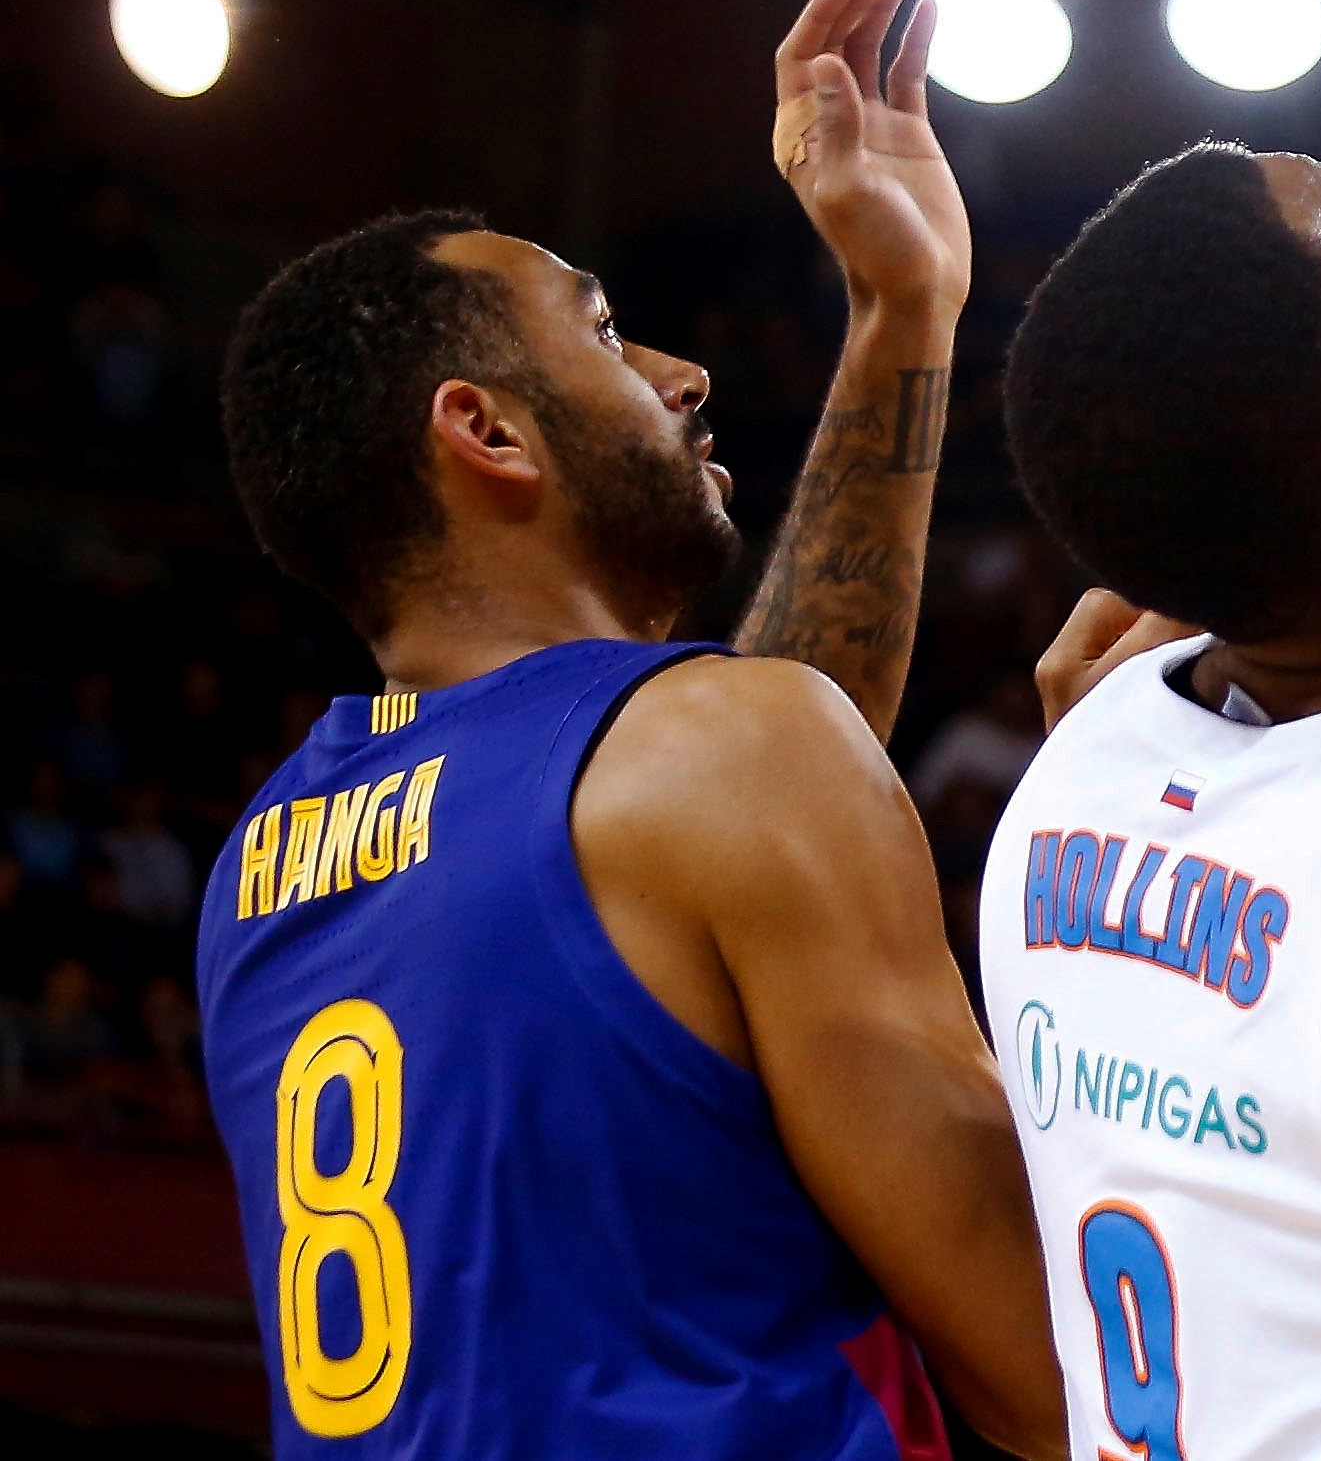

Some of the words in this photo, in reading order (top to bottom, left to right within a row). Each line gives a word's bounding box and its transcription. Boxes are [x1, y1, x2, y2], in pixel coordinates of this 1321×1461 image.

[237, 754, 447, 921] HANGA
[1024, 829, 1291, 1009] HOLLINS
[1074, 1047, 1269, 1155] NIPIGAS
[276, 997, 412, 1439] 8
[1078, 1197, 1189, 1461] 9
